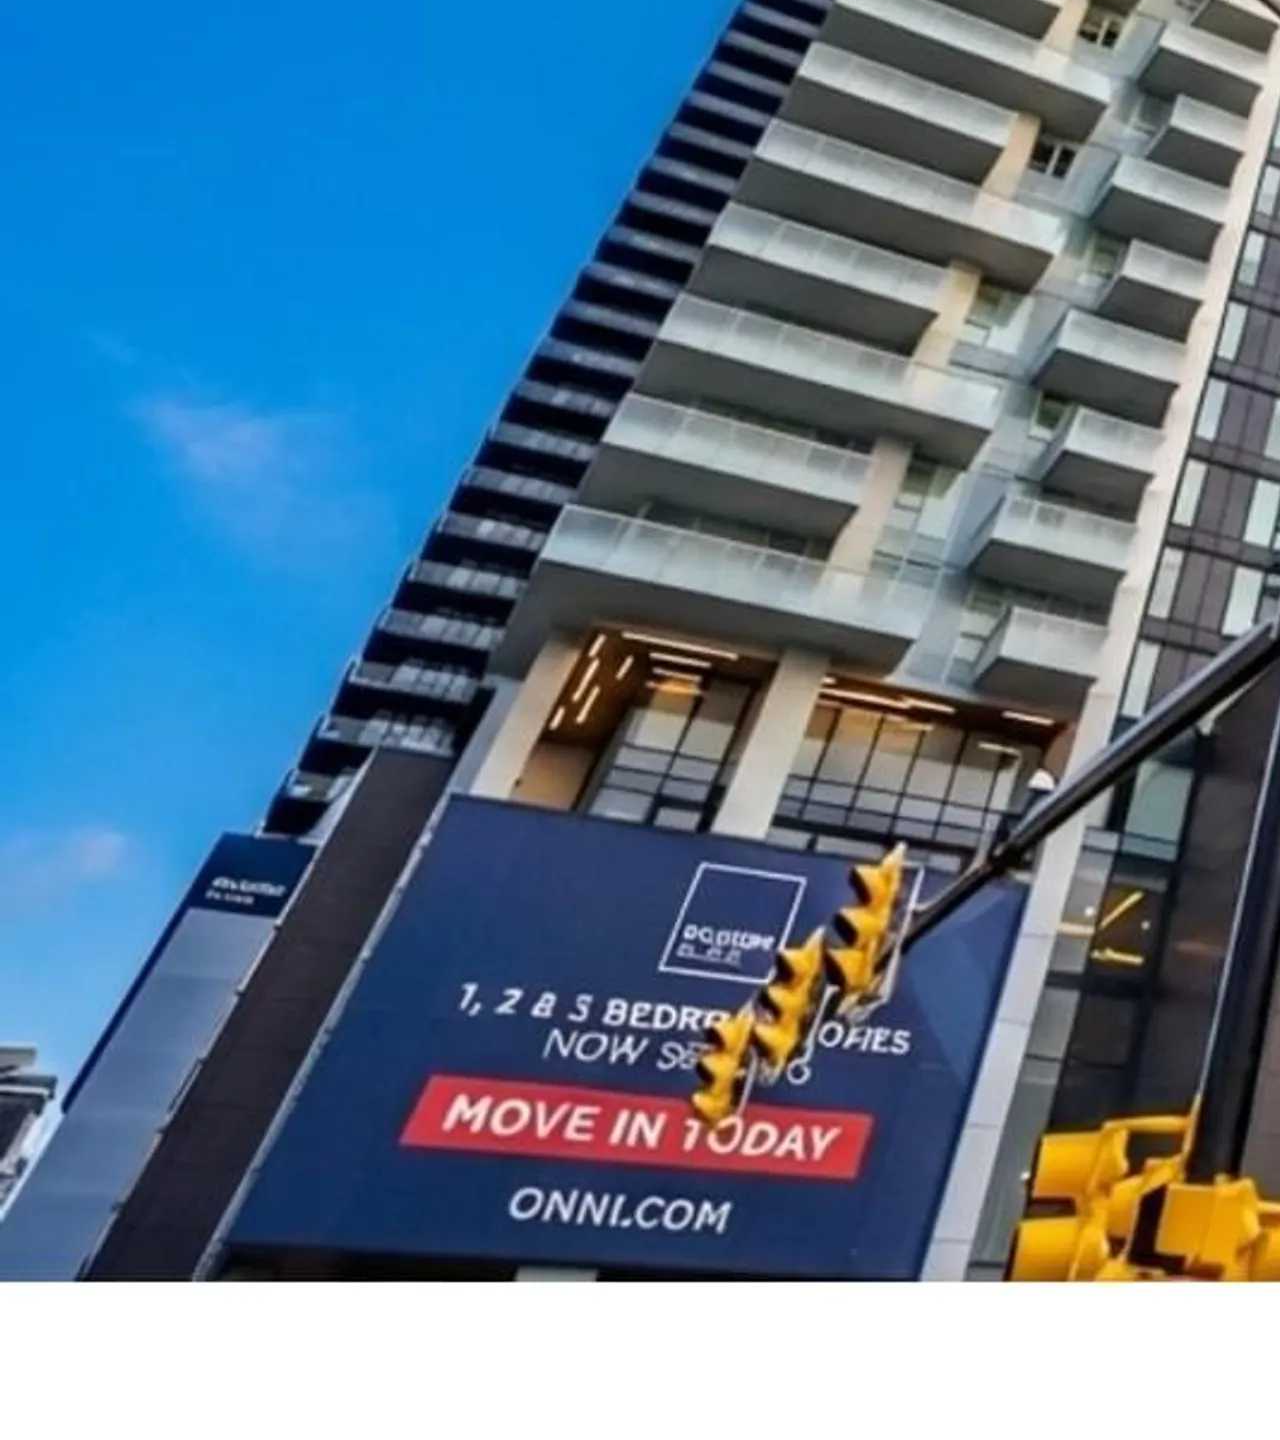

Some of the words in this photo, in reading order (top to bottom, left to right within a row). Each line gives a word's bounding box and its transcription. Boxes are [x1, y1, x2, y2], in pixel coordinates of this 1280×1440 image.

[494, 988, 524, 1015] 2
[541, 1027, 649, 1065] NOW
[441, 1093, 601, 1142] MOVE
[608, 1109, 666, 1149] IN
[683, 1116, 842, 1161] TODAY
[508, 1186, 734, 1235] ONNI.COM
